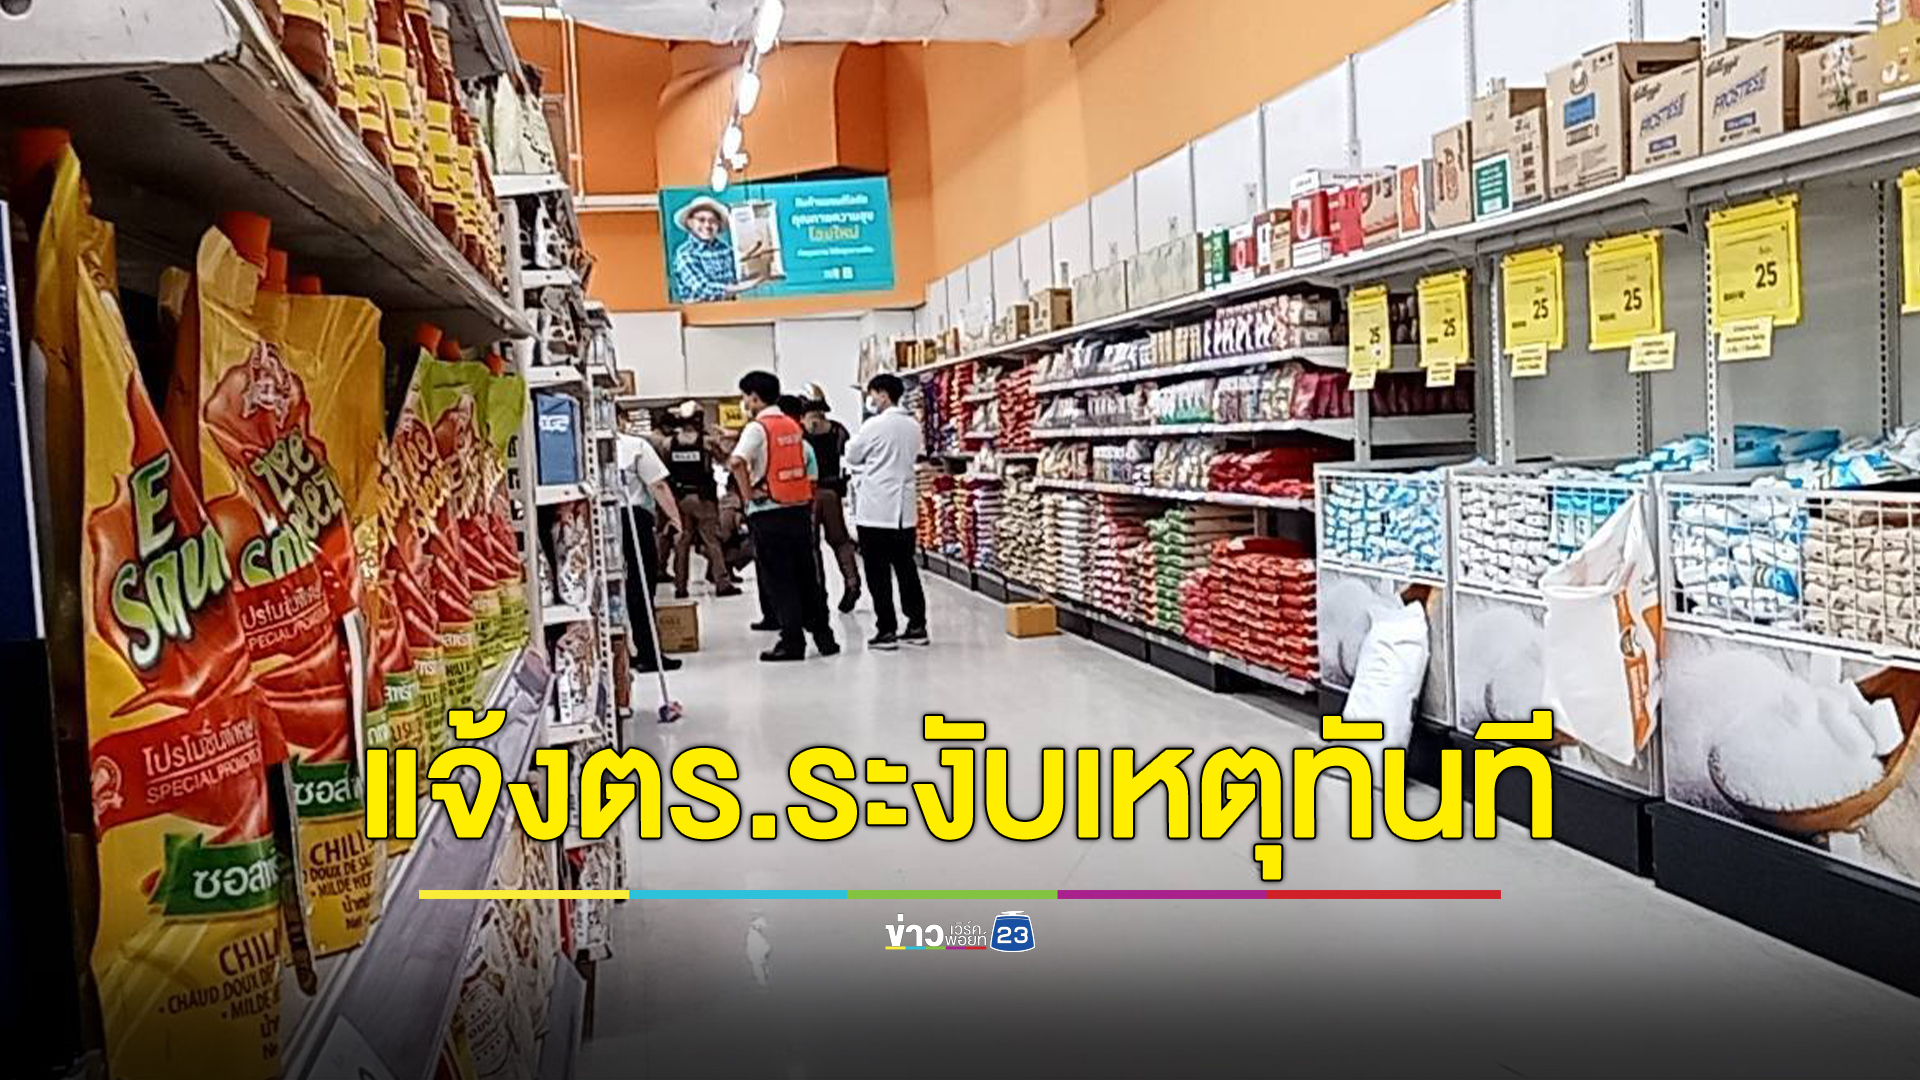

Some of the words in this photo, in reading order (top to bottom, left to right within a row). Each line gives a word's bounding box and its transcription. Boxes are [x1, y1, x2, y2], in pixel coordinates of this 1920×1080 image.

[1755, 261, 1778, 289] 25
[1532, 299, 1549, 320] 25
[1624, 288, 1643, 312] 25
[1368, 326, 1381, 345] 25
[1443, 318, 1457, 337] 25
[167, 986, 219, 1014] CHAUD
[222, 976, 258, 1002] DOUX
